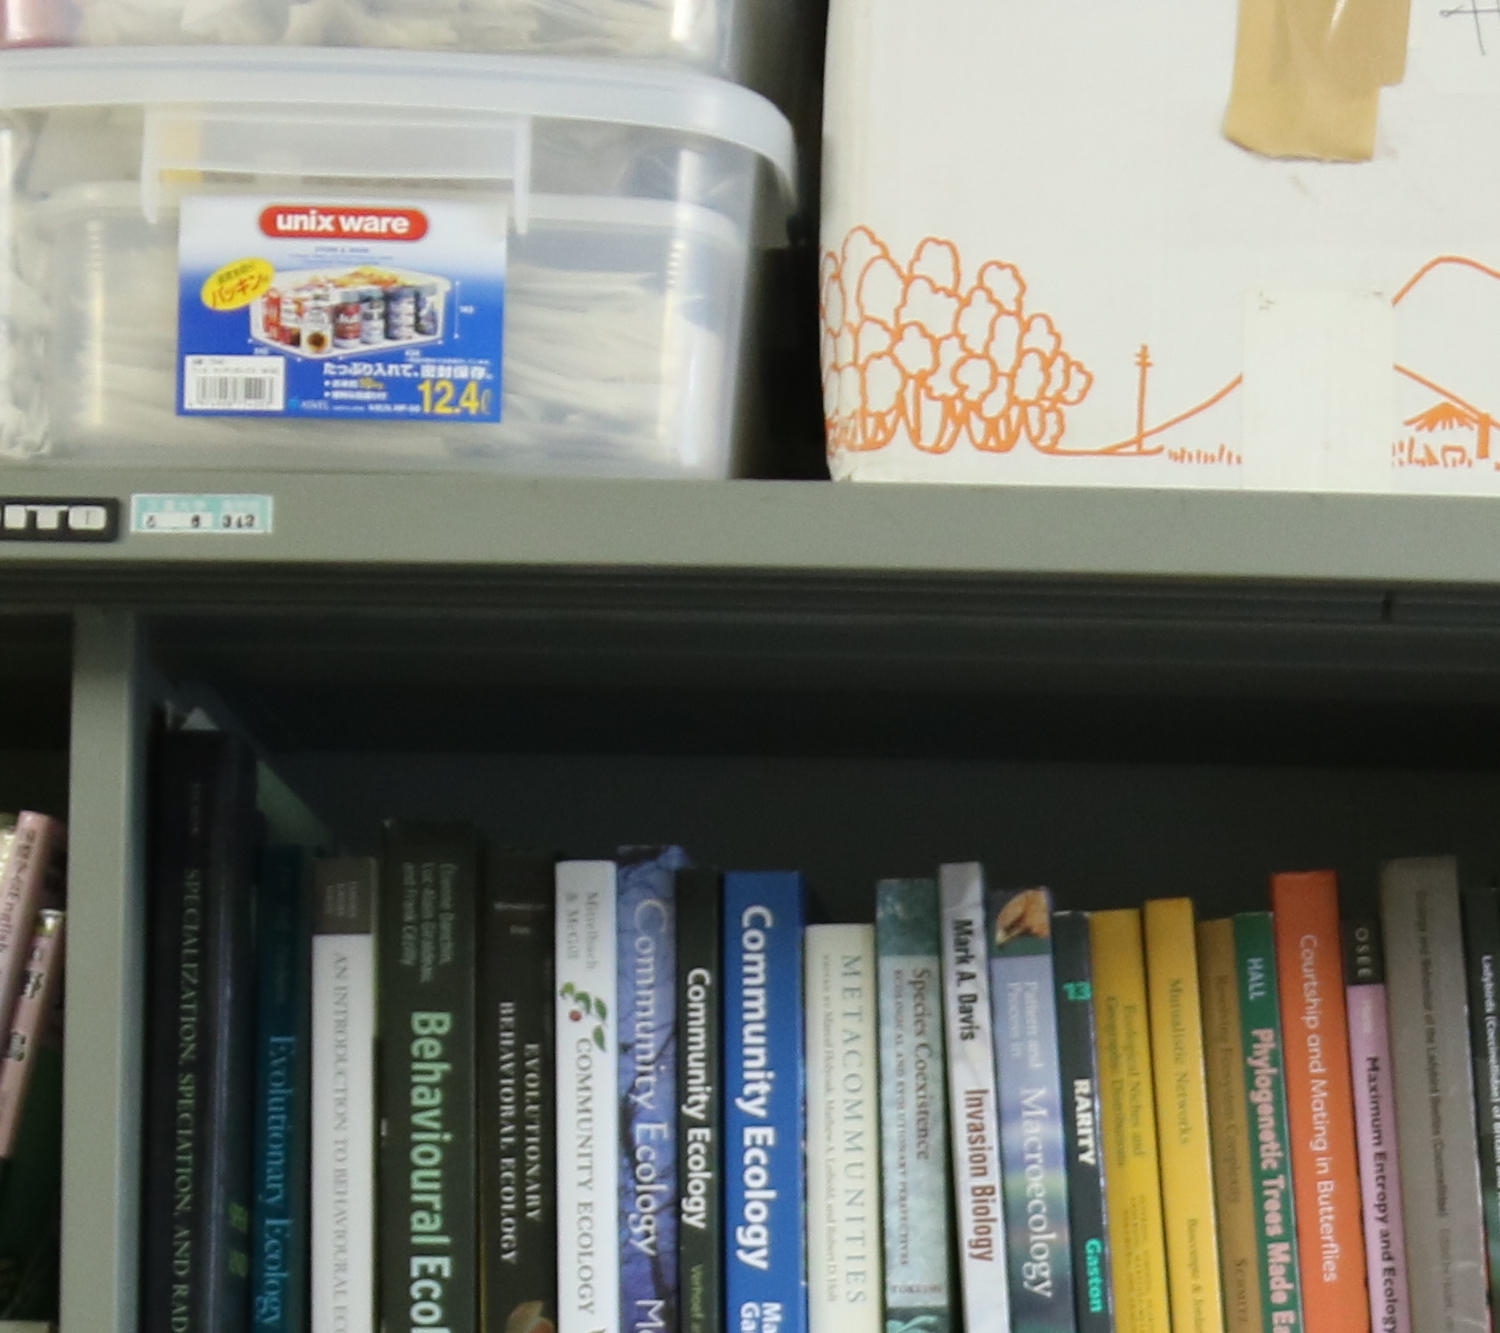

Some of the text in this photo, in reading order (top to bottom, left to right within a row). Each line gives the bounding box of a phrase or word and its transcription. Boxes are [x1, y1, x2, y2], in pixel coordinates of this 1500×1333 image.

[277, 211, 410, 234] unix ware
[630, 898, 668, 1113] Community
[952, 919, 979, 1042] Mark Davis
[1247, 957, 1264, 999] HALL
[410, 1011, 453, 1245] Behavioural
[499, 1001, 516, 1148] BEHAVIORAL
[524, 1043, 542, 1223] EVOLUTIONARY
[680, 968, 712, 1231] Community Ecology
[740, 905, 776, 1270] Community Ecology
[841, 953, 867, 1304] METACOMMUNITIES
[1073, 1078, 1096, 1166] RARITY
[1251, 1028, 1280, 1172] Phylogenetic
[1300, 934, 1341, 1284] Courtship and Mating Butterflies
[1365, 1056, 1383, 1147] Maximum
[574, 1037, 595, 1317] COMMUNITY ECOLOGY
[628, 1122, 671, 1258] Ecology
[964, 1088, 998, 1263] Invasion Biology
[1020, 1086, 1052, 1298] Macroecology
[1262, 1175, 1284, 1237] Trees
[1373, 1153, 1391, 1224] Entropy
[1085, 1238, 1103, 1313] Gaston
[1267, 1242, 1292, 1305] Made
